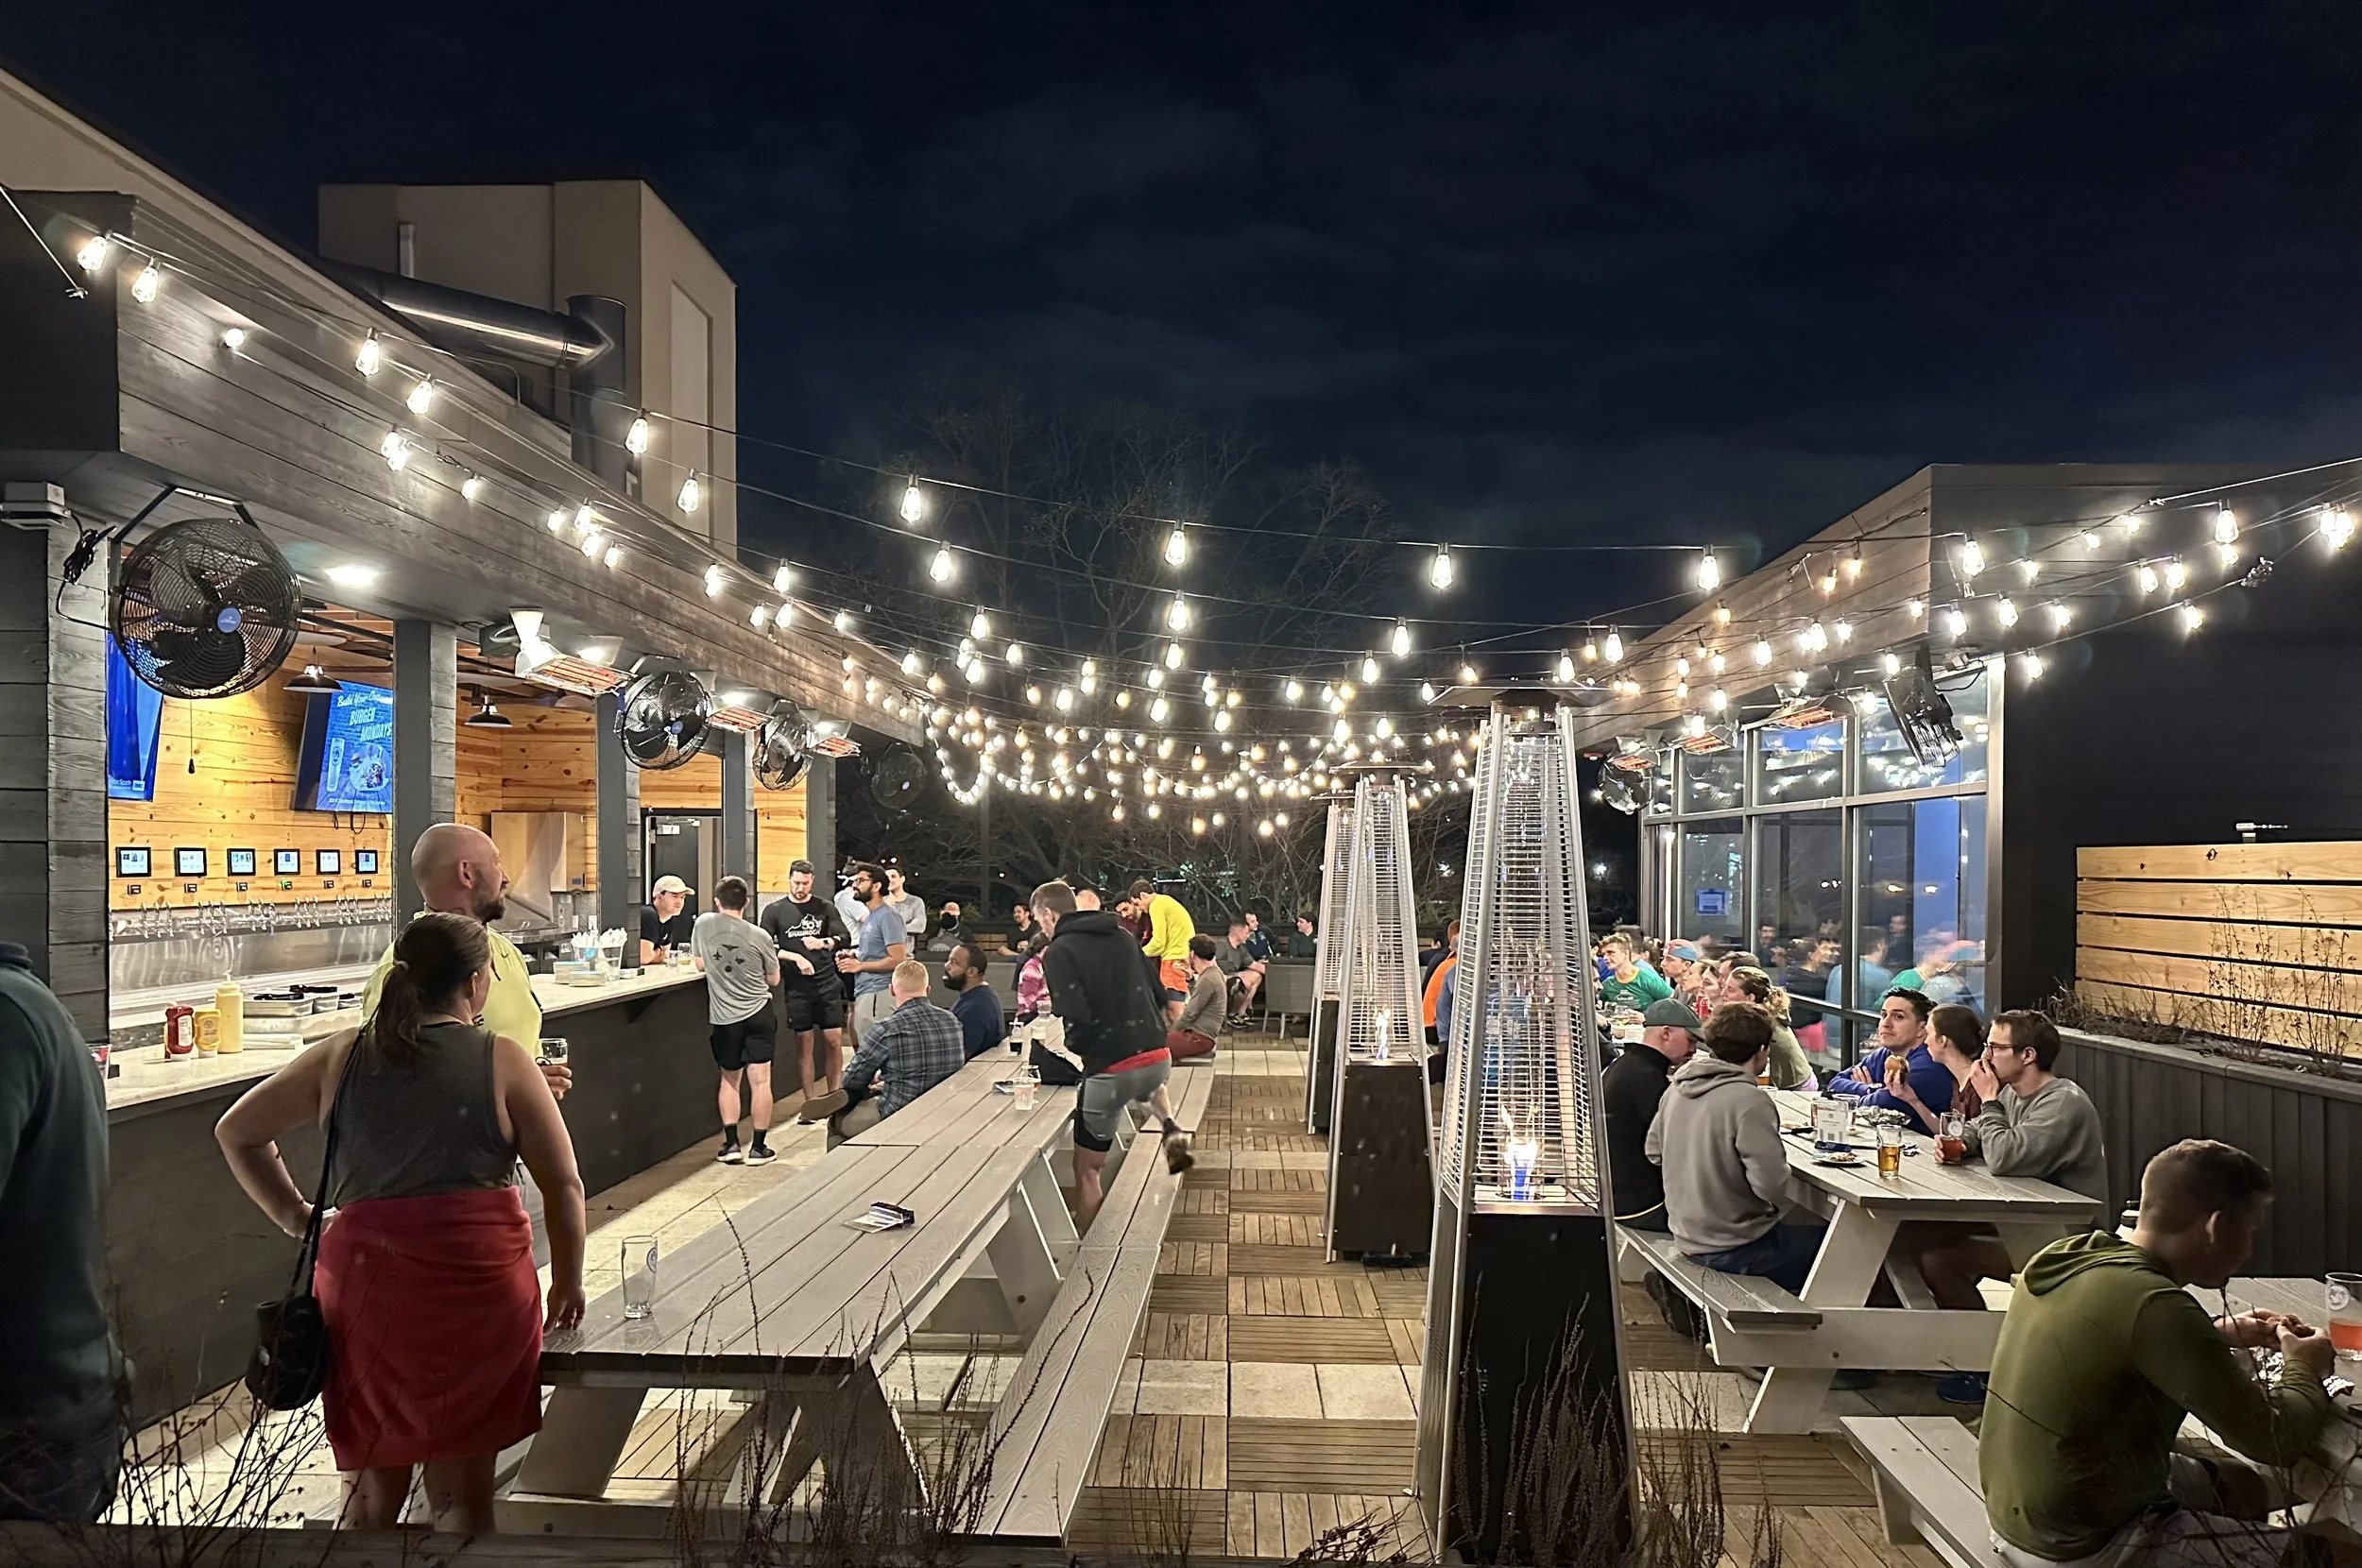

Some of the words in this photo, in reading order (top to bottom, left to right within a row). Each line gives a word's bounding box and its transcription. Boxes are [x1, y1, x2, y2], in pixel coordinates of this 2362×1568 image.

[337, 693, 354, 707] Build
[350, 707, 376, 725] BURGER
[360, 722, 393, 742] MONDAYS
[787, 929, 821, 938] SHAMROCK
